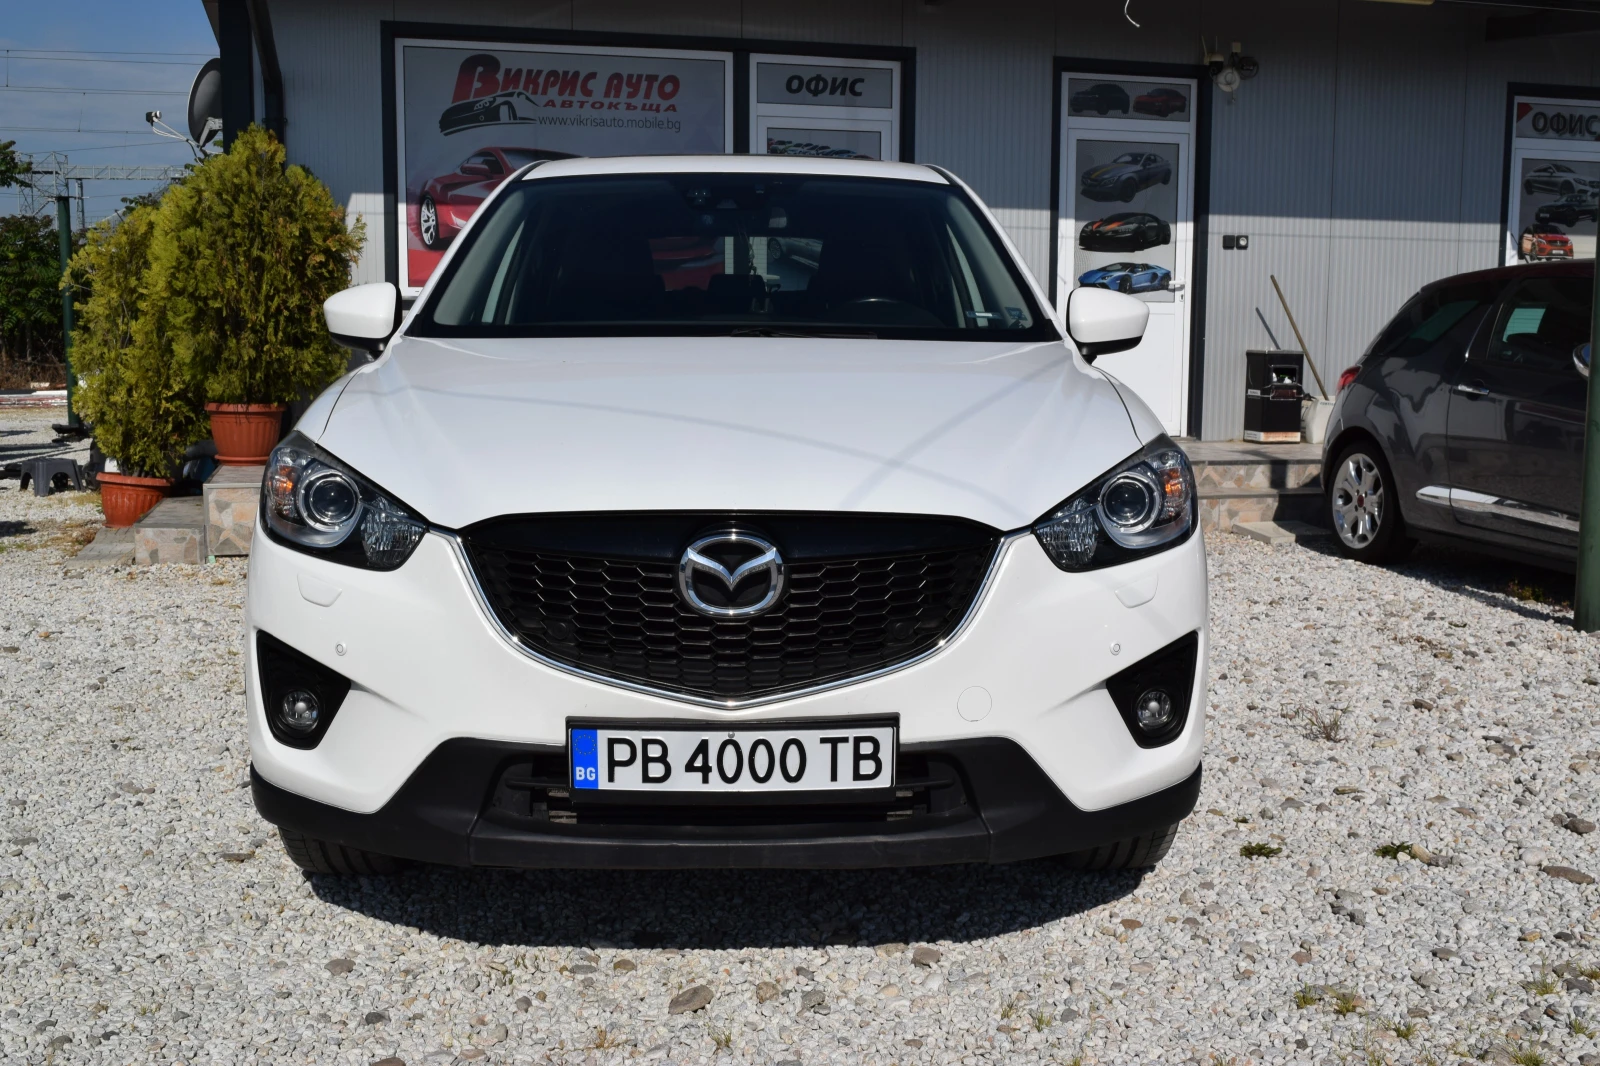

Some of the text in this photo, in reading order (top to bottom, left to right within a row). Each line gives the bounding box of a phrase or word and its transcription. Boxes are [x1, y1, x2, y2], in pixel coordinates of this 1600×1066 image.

[452, 53, 681, 105] ВИКРИС АУТО
[785, 73, 865, 97] ОФИС
[543, 98, 678, 114] АВТОКЪЩА
[538, 114, 682, 133] www.vikrisauto.mobile.bg
[1531, 111, 1599, 136] ОФИС
[607, 734, 883, 784] PB 4000 TB
[575, 766, 596, 781] BG
